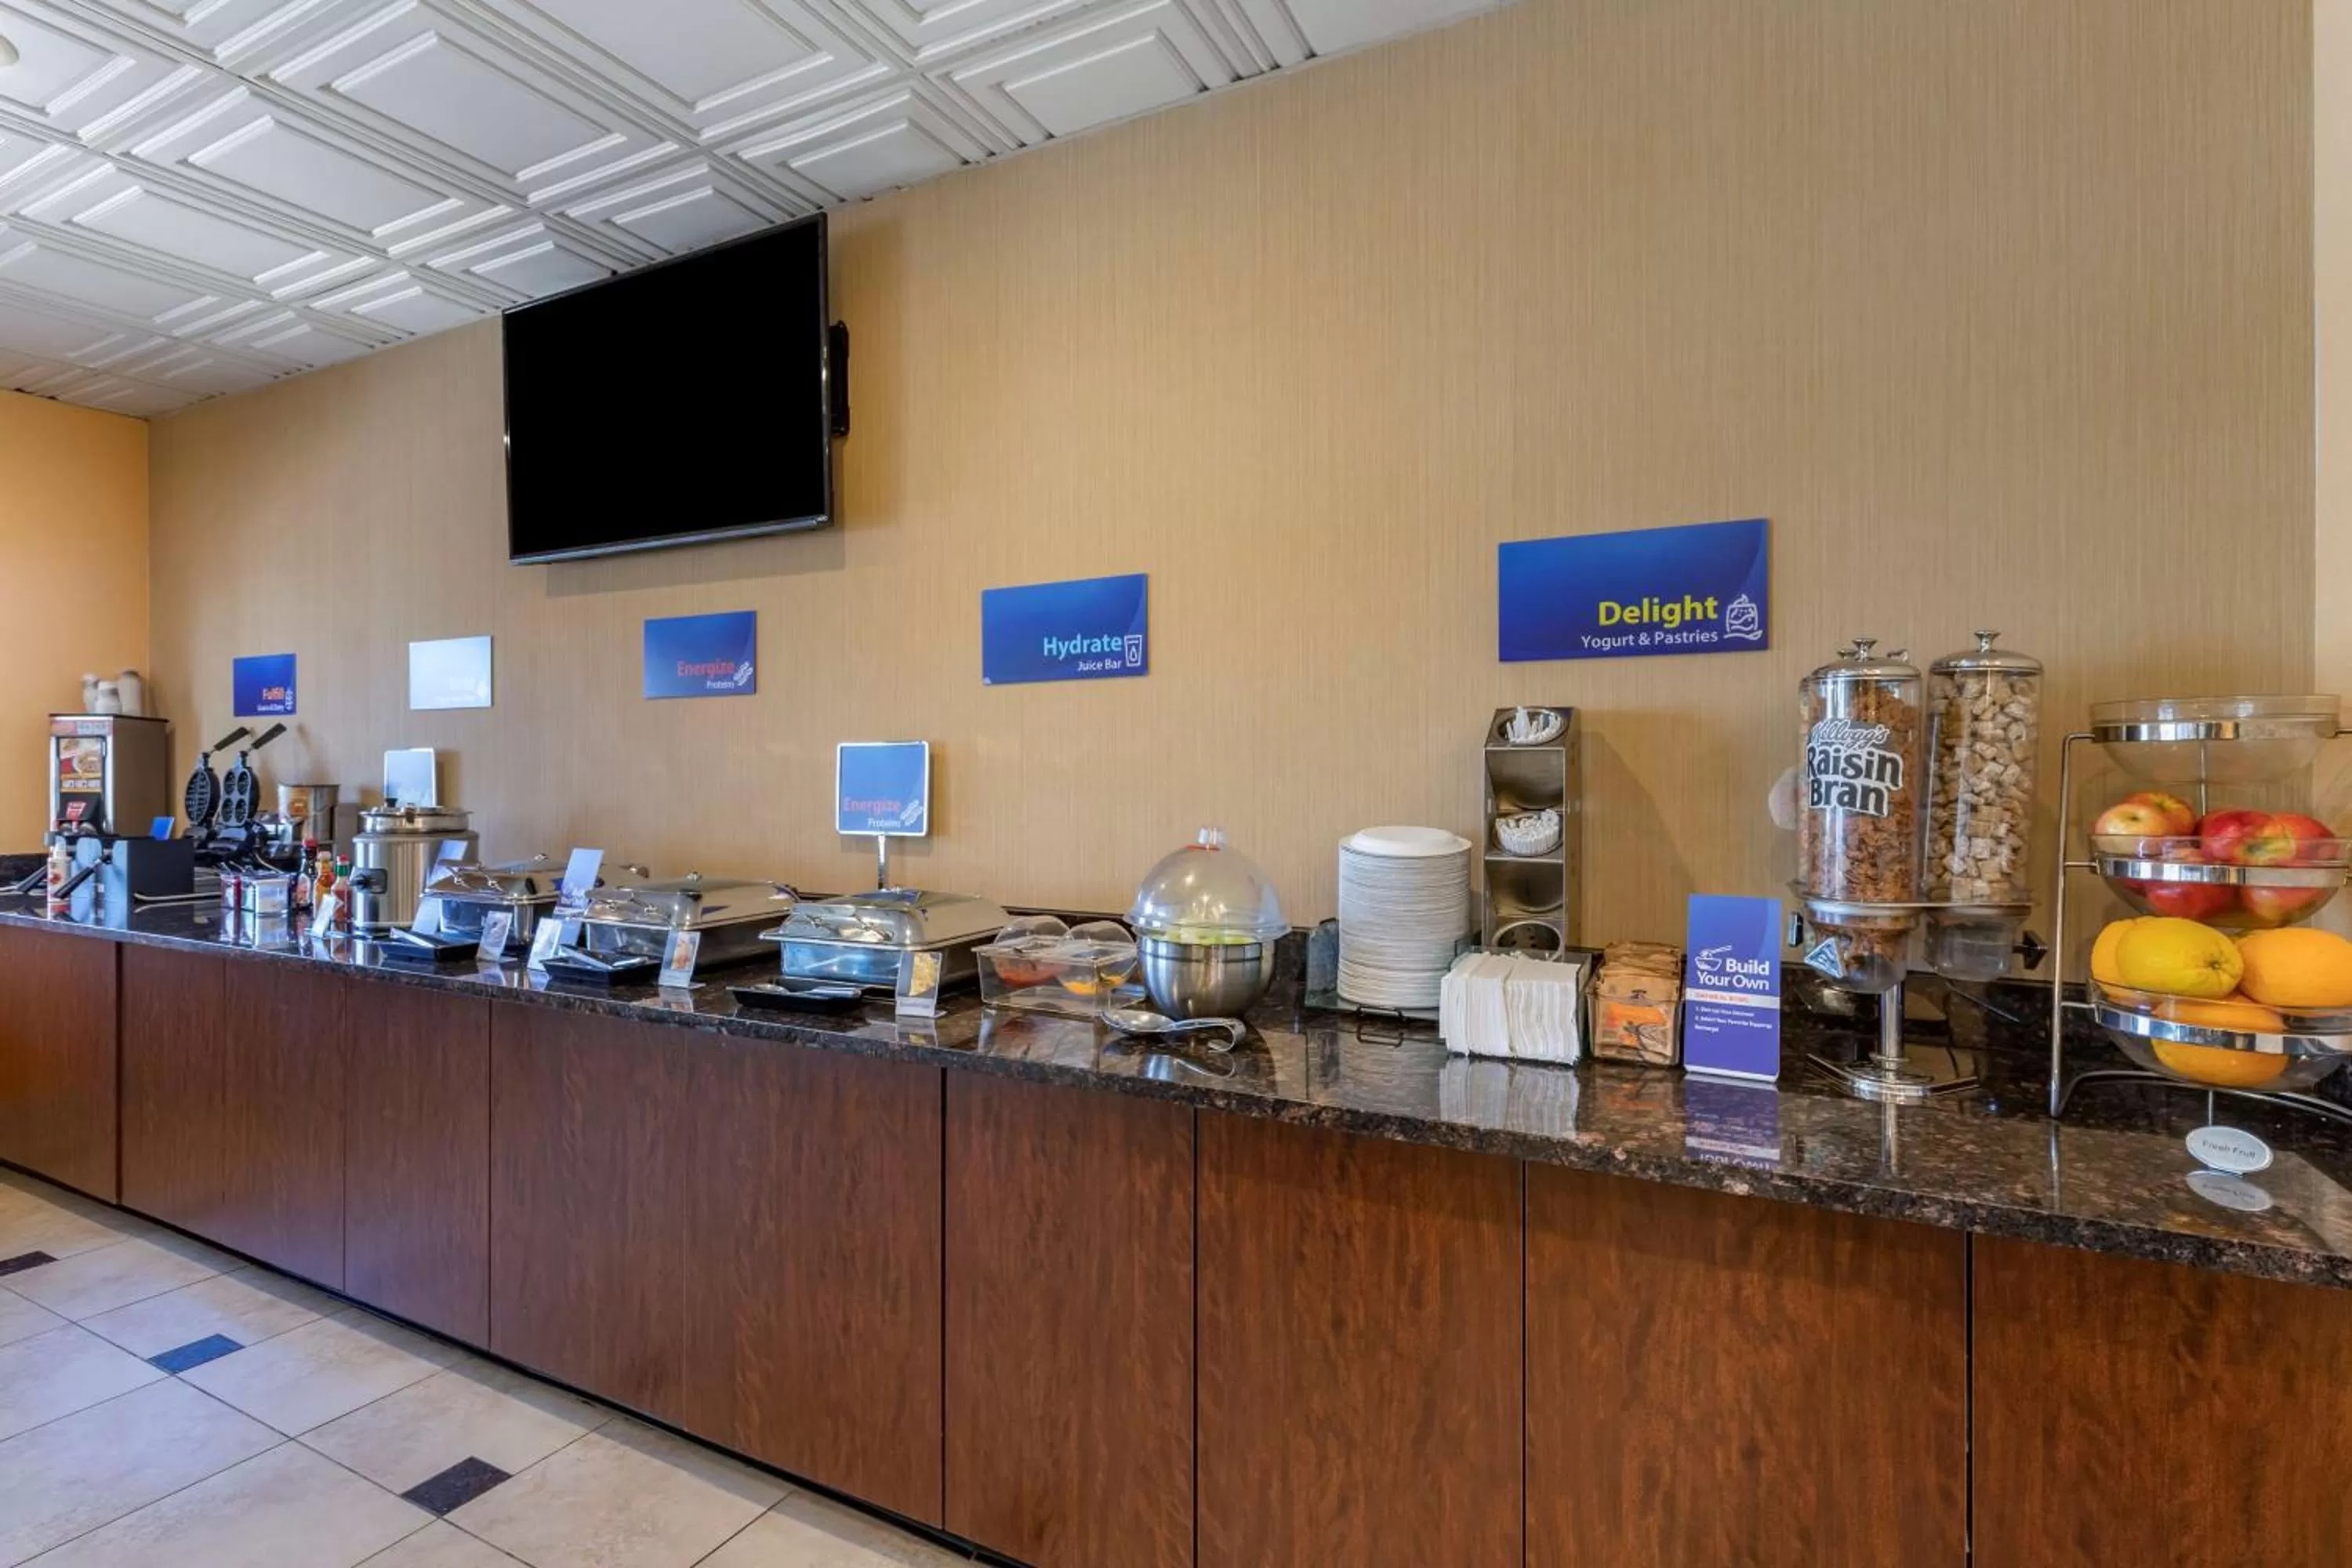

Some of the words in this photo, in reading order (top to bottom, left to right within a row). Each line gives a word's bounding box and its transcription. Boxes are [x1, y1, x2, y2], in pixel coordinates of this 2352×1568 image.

[1599, 594, 1718, 628] Delight
[1044, 633, 1122, 661] Hydrate
[1581, 634, 1635, 651] Yogurt
[1638, 632, 1650, 645] &
[1655, 630, 1718, 644] Pastries
[677, 659, 735, 679] Energize
[1077, 660, 1103, 672] Juice
[1105, 658, 1122, 670] Bar
[1809, 717, 1890, 751] Kellogg's
[1807, 745, 1903, 789] Raisin
[1809, 777, 1888, 817] Bran
[1726, 958, 1769, 976] Build
[1697, 971, 1731, 986] Your
[1733, 975, 1769, 991] Own
[2202, 1139, 2230, 1152] Fresh
[2232, 1147, 2256, 1160] Fruit
